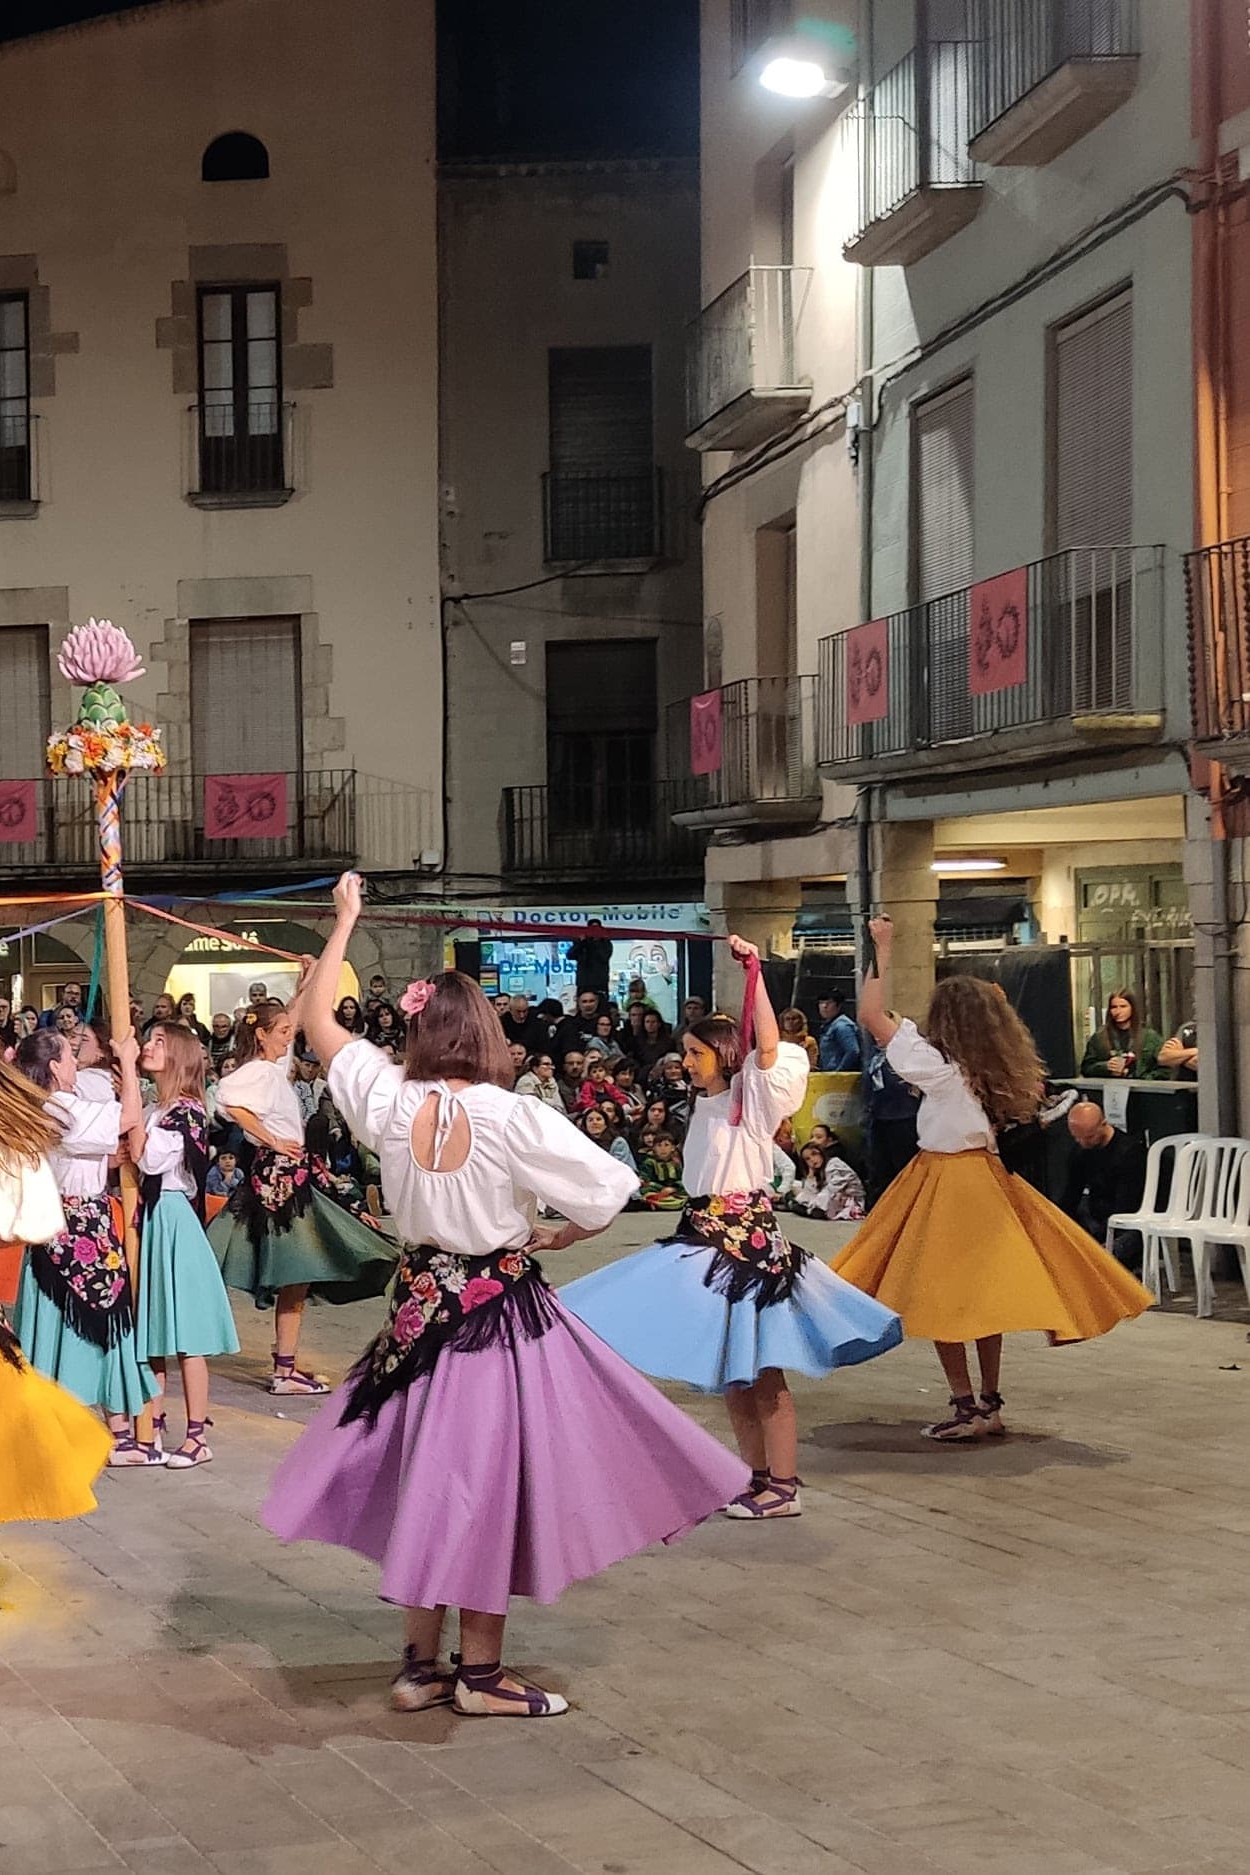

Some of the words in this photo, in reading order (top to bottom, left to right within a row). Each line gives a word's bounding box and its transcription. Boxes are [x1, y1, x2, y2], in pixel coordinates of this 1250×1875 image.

[513, 910, 589, 924] Doctor
[602, 904, 680, 921] Mobile
[534, 958, 577, 974] Mob
